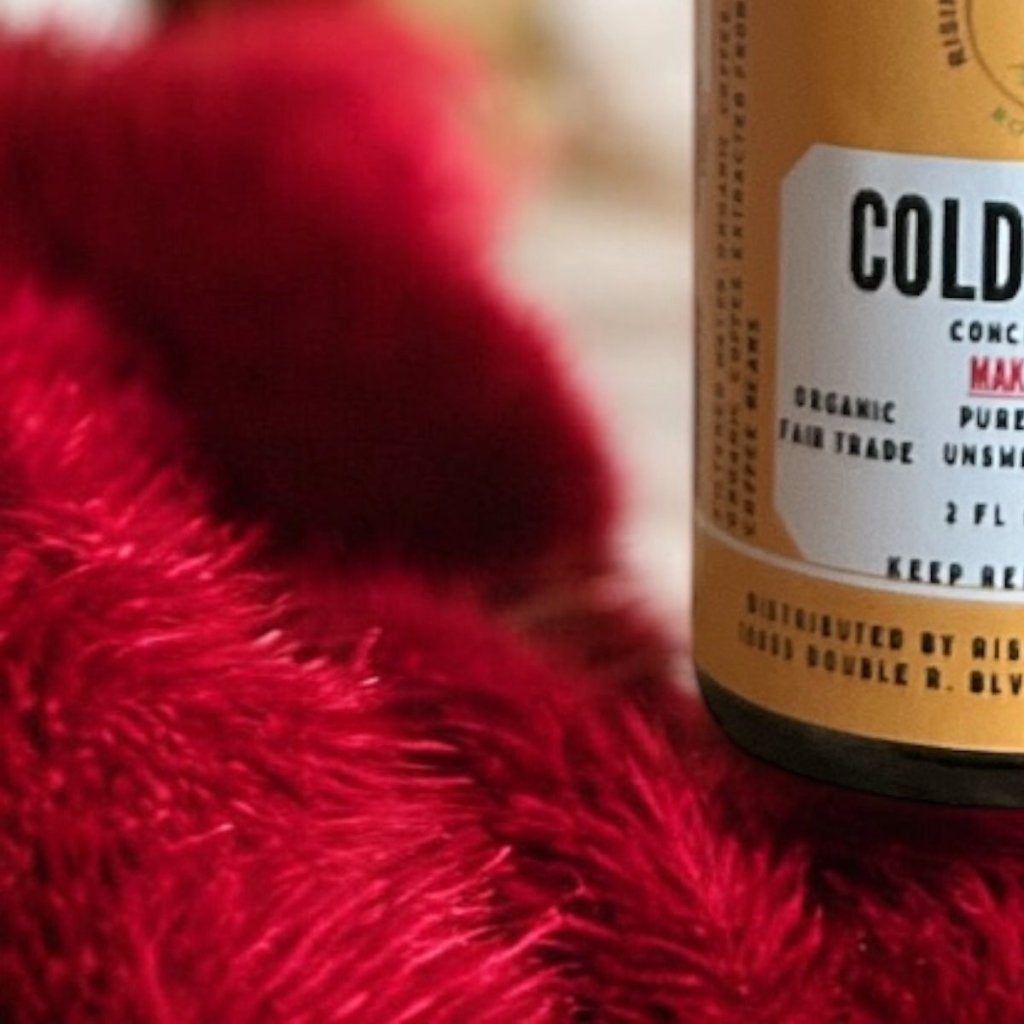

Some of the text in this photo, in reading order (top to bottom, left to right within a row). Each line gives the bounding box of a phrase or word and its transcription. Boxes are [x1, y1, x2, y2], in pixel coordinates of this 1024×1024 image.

[849, 188, 1024, 302] COLD
[794, 384, 896, 424] ORGANIC
[779, 418, 914, 465] FAIR TRADE
[945, 500, 958, 526] 2
[974, 502, 1005, 527] FL
[887, 555, 964, 587] KEEP
[746, 591, 904, 651] DISTRIBUTED
[920, 631, 955, 657] BY
[806, 643, 908, 687] DOUBLE
